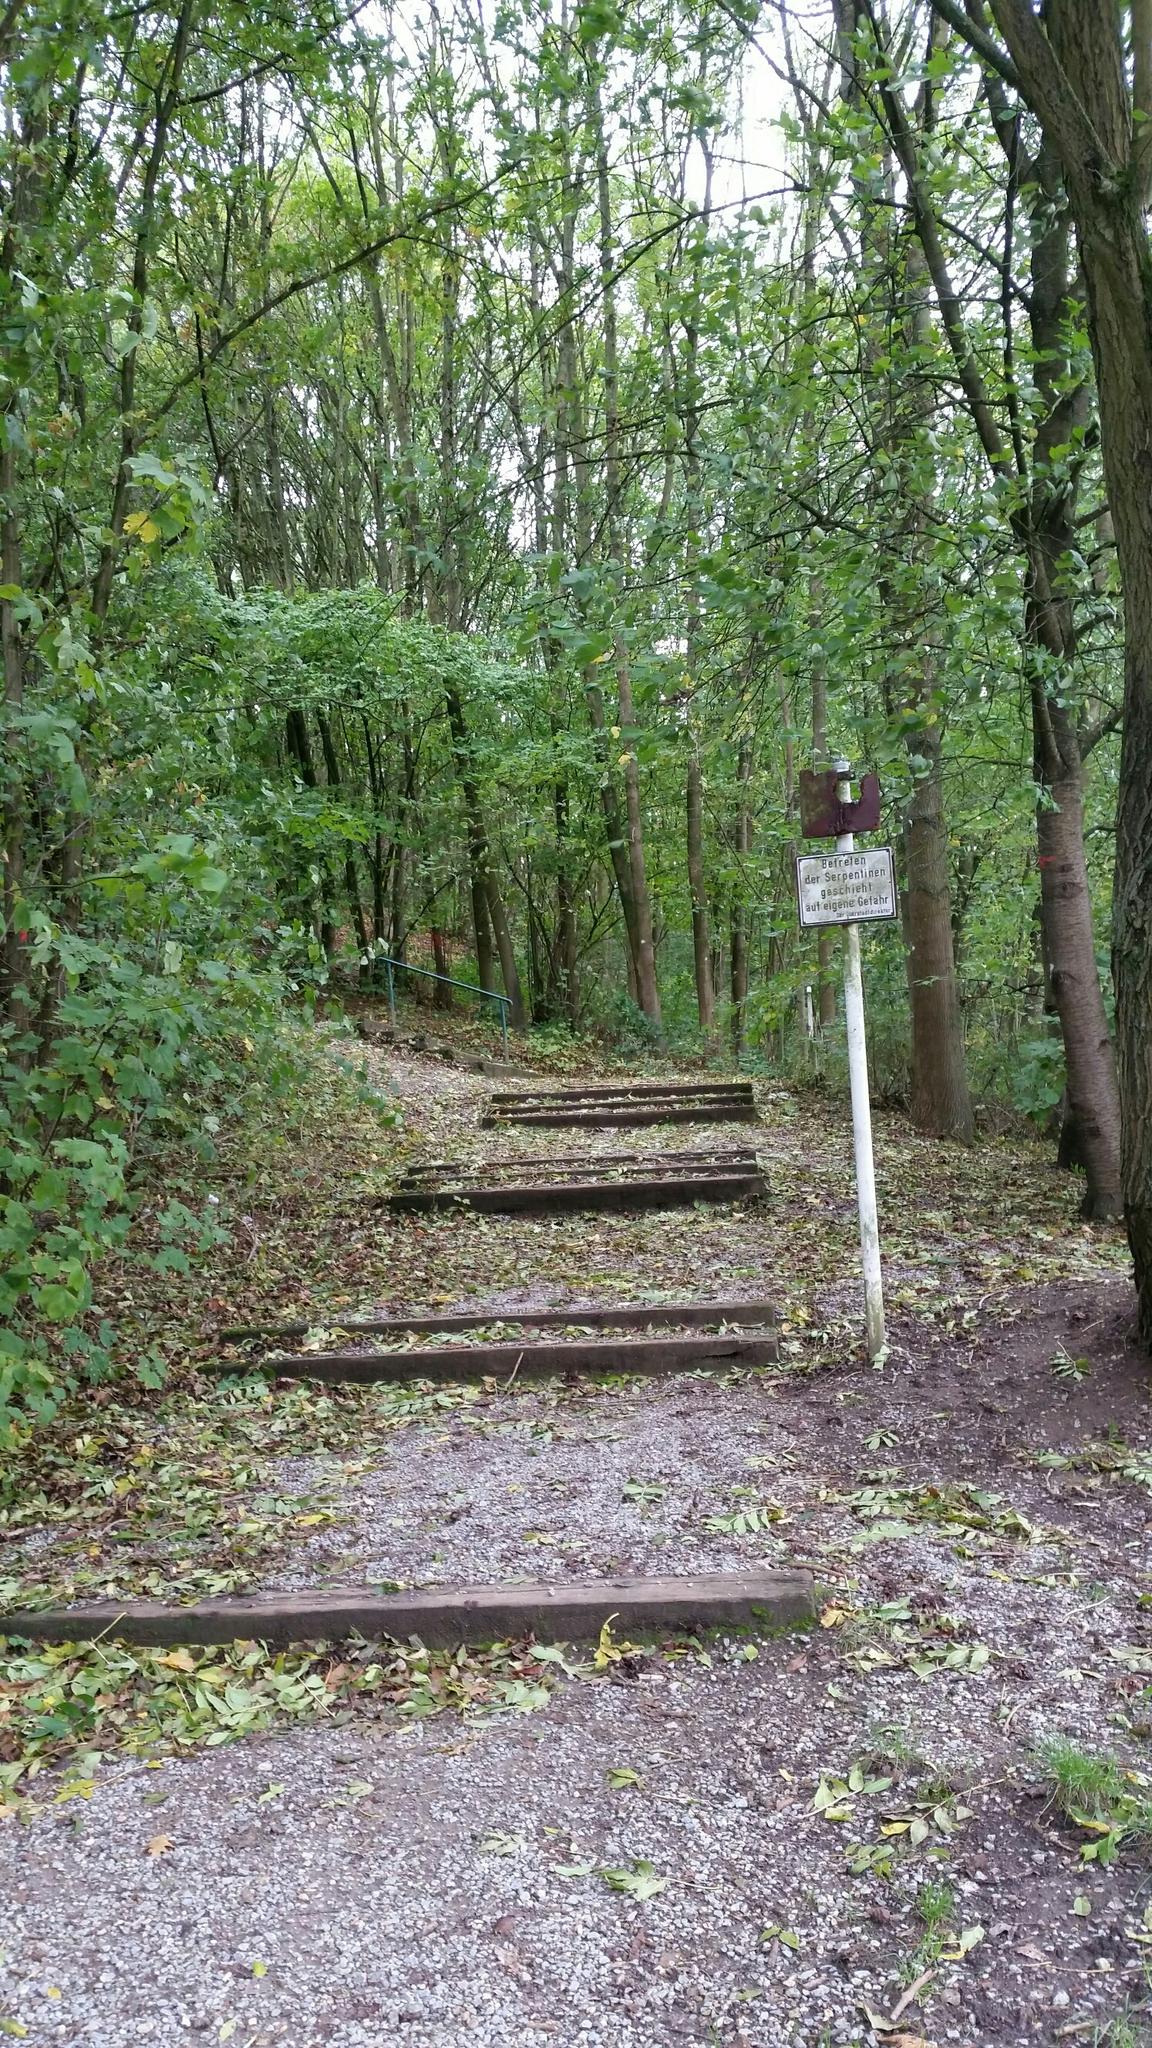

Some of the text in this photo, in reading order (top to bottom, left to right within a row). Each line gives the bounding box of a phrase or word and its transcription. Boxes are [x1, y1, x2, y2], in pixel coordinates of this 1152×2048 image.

[822, 857, 866, 869] Betreten
[805, 868, 886, 884] der Serpentinen
[821, 882, 872, 899] geschieht
[806, 896, 888, 912] auf eigene Gefahr
